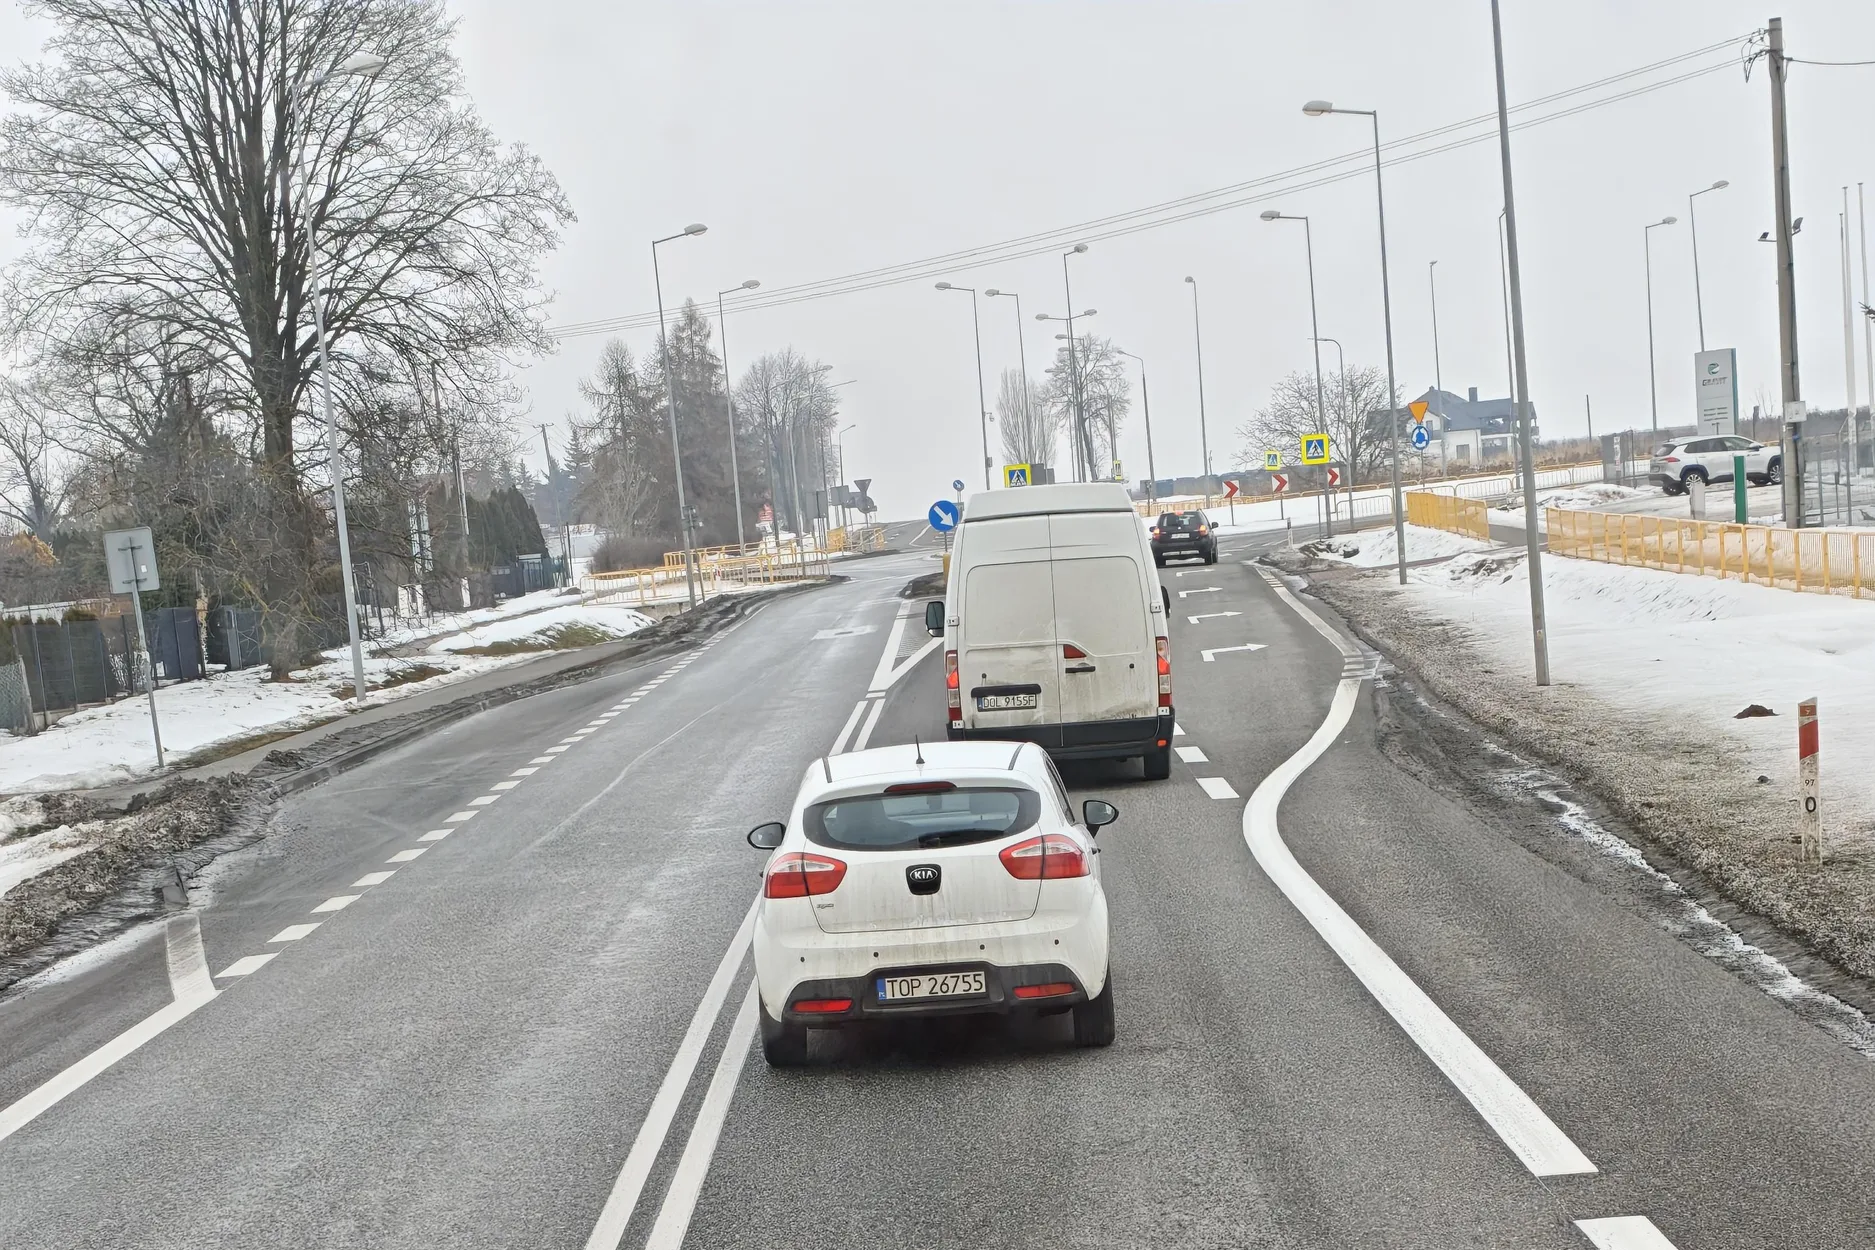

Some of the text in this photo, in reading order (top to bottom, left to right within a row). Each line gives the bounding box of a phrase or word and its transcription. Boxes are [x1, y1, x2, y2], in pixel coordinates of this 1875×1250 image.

[984, 697, 1001, 708] DOL
[1805, 779, 1815, 787] 97
[1805, 796, 1817, 813] 0
[914, 870, 933, 879] KIA
[886, 973, 984, 998] TOP 26755
